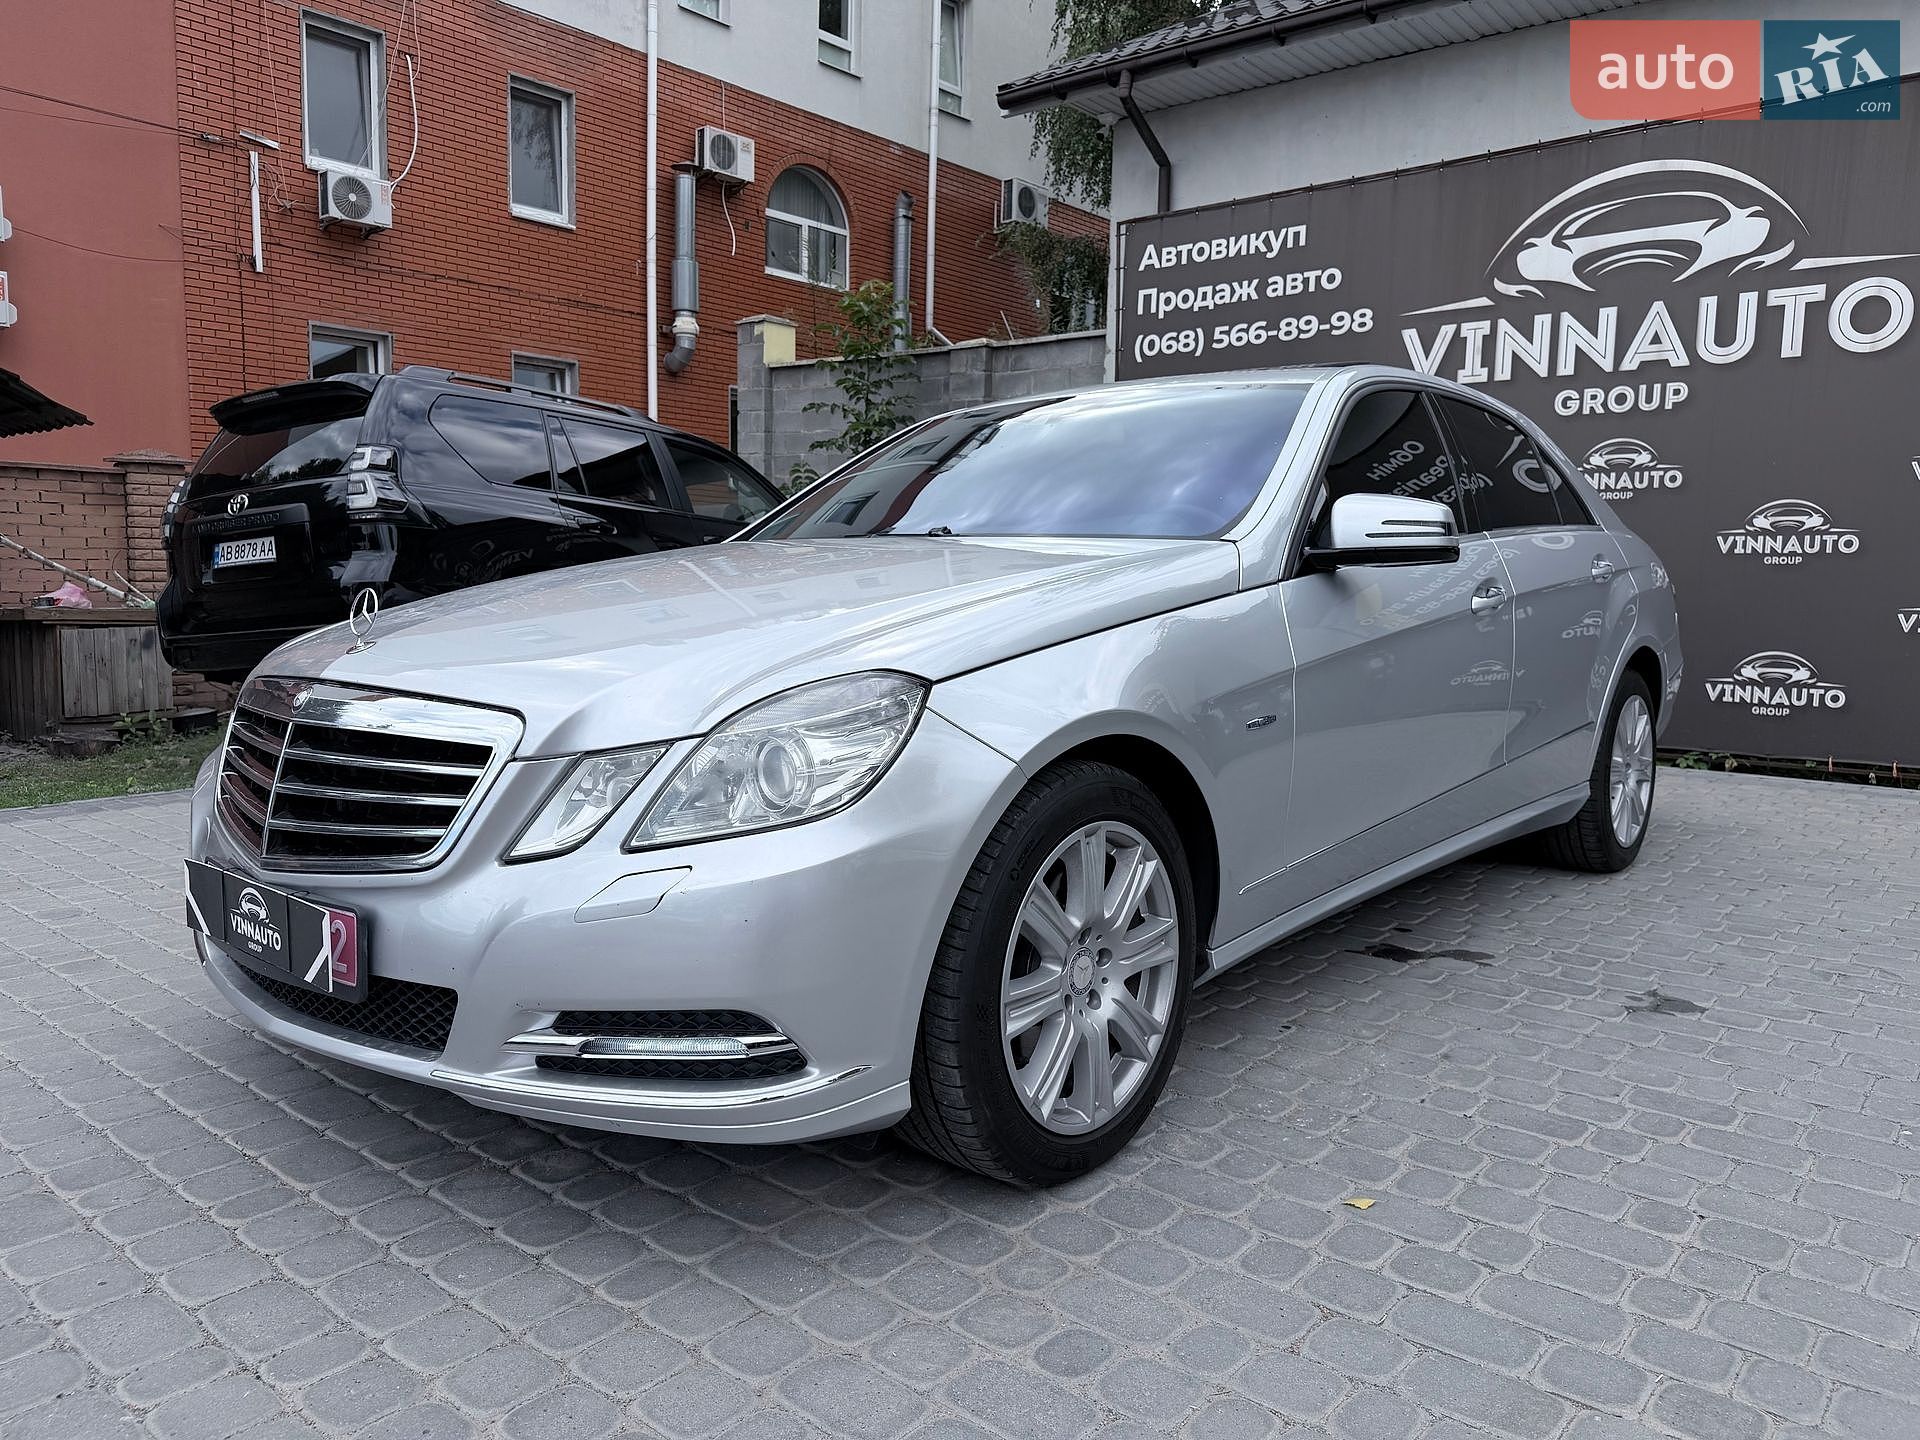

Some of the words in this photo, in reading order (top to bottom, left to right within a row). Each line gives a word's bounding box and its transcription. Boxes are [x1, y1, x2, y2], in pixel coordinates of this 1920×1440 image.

[1138, 224, 1307, 272] Автовикуп
[1136, 278, 1260, 319] Продаж
[1266, 267, 1342, 298] авто
[1134, 327, 1204, 362] (068)
[1211, 308, 1374, 349] 566-89-98
[1400, 276, 1915, 384] VINNAUTO
[1554, 382, 1689, 416] GROUP
[1584, 469, 1683, 490] NNAUTO
[219, 544, 233, 562] AB
[234, 542, 258, 560] 8878
[259, 540, 274, 557] AA
[1717, 534, 1859, 554] VINNAUTO
[1763, 556, 1802, 565] GROUP
[1705, 683, 1846, 708] VINNAUTO
[1752, 706, 1790, 716] GROUP
[230, 913, 282, 951] VINNAUTO
[331, 919, 348, 973] 2
[248, 941, 263, 953] GROUP
